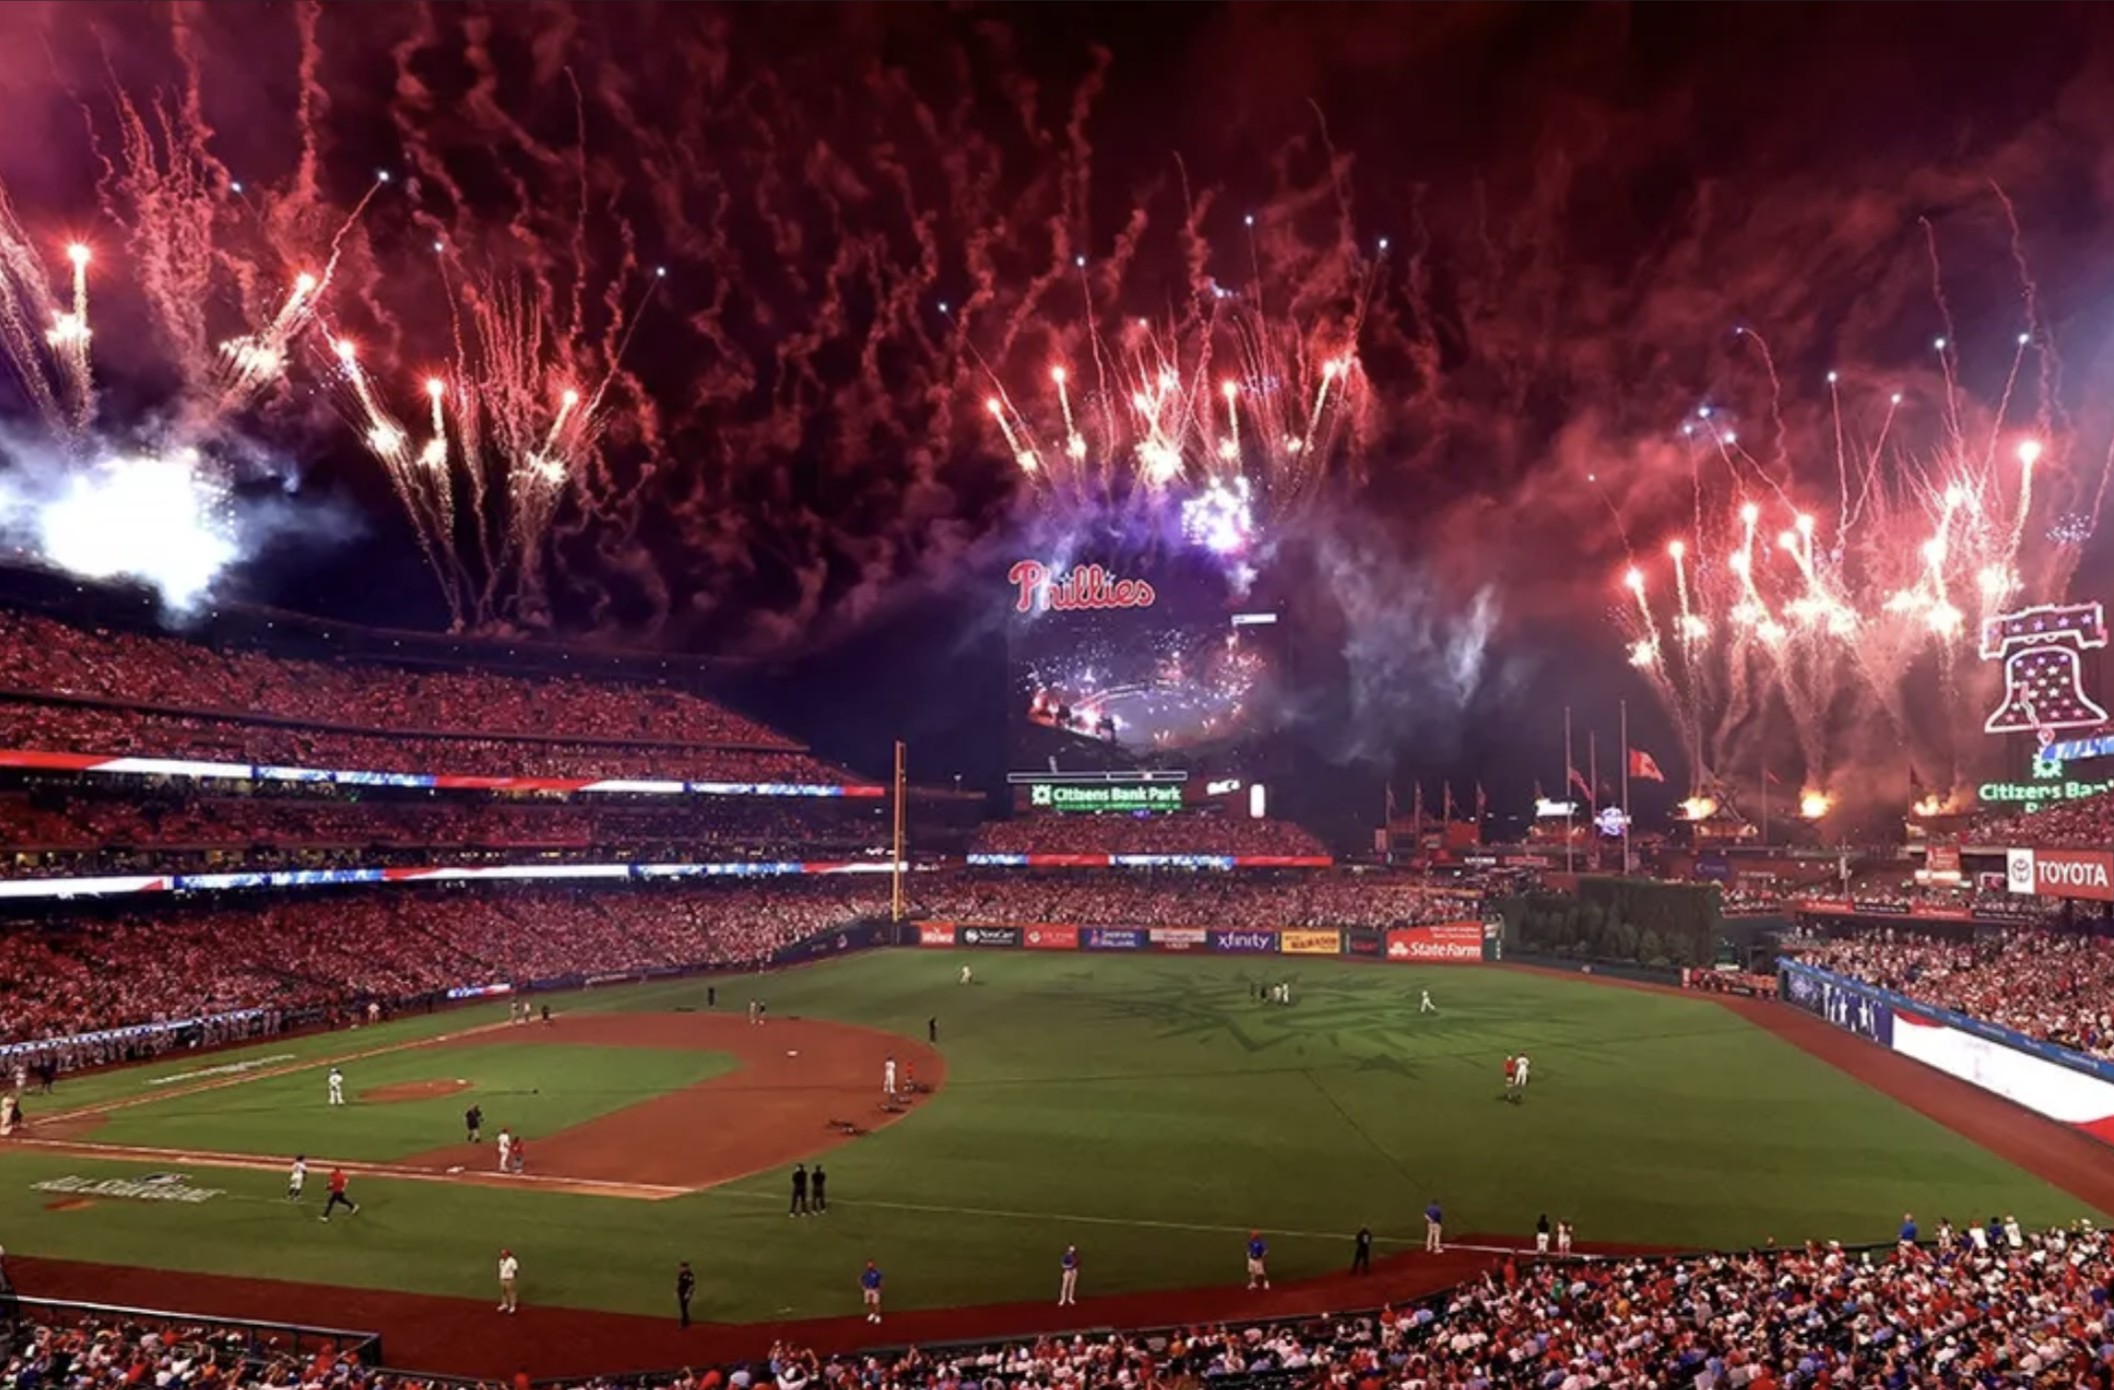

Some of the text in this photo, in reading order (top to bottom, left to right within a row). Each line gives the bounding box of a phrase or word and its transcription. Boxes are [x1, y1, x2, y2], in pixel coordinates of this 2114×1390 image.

[1008, 560, 1155, 612] Phillies
[1053, 785, 1181, 801] Citizens Bank Park
[1979, 783, 2061, 800] Citizens
[2037, 861, 2109, 887] TOYOTA
[1217, 931, 1269, 949] xfinity
